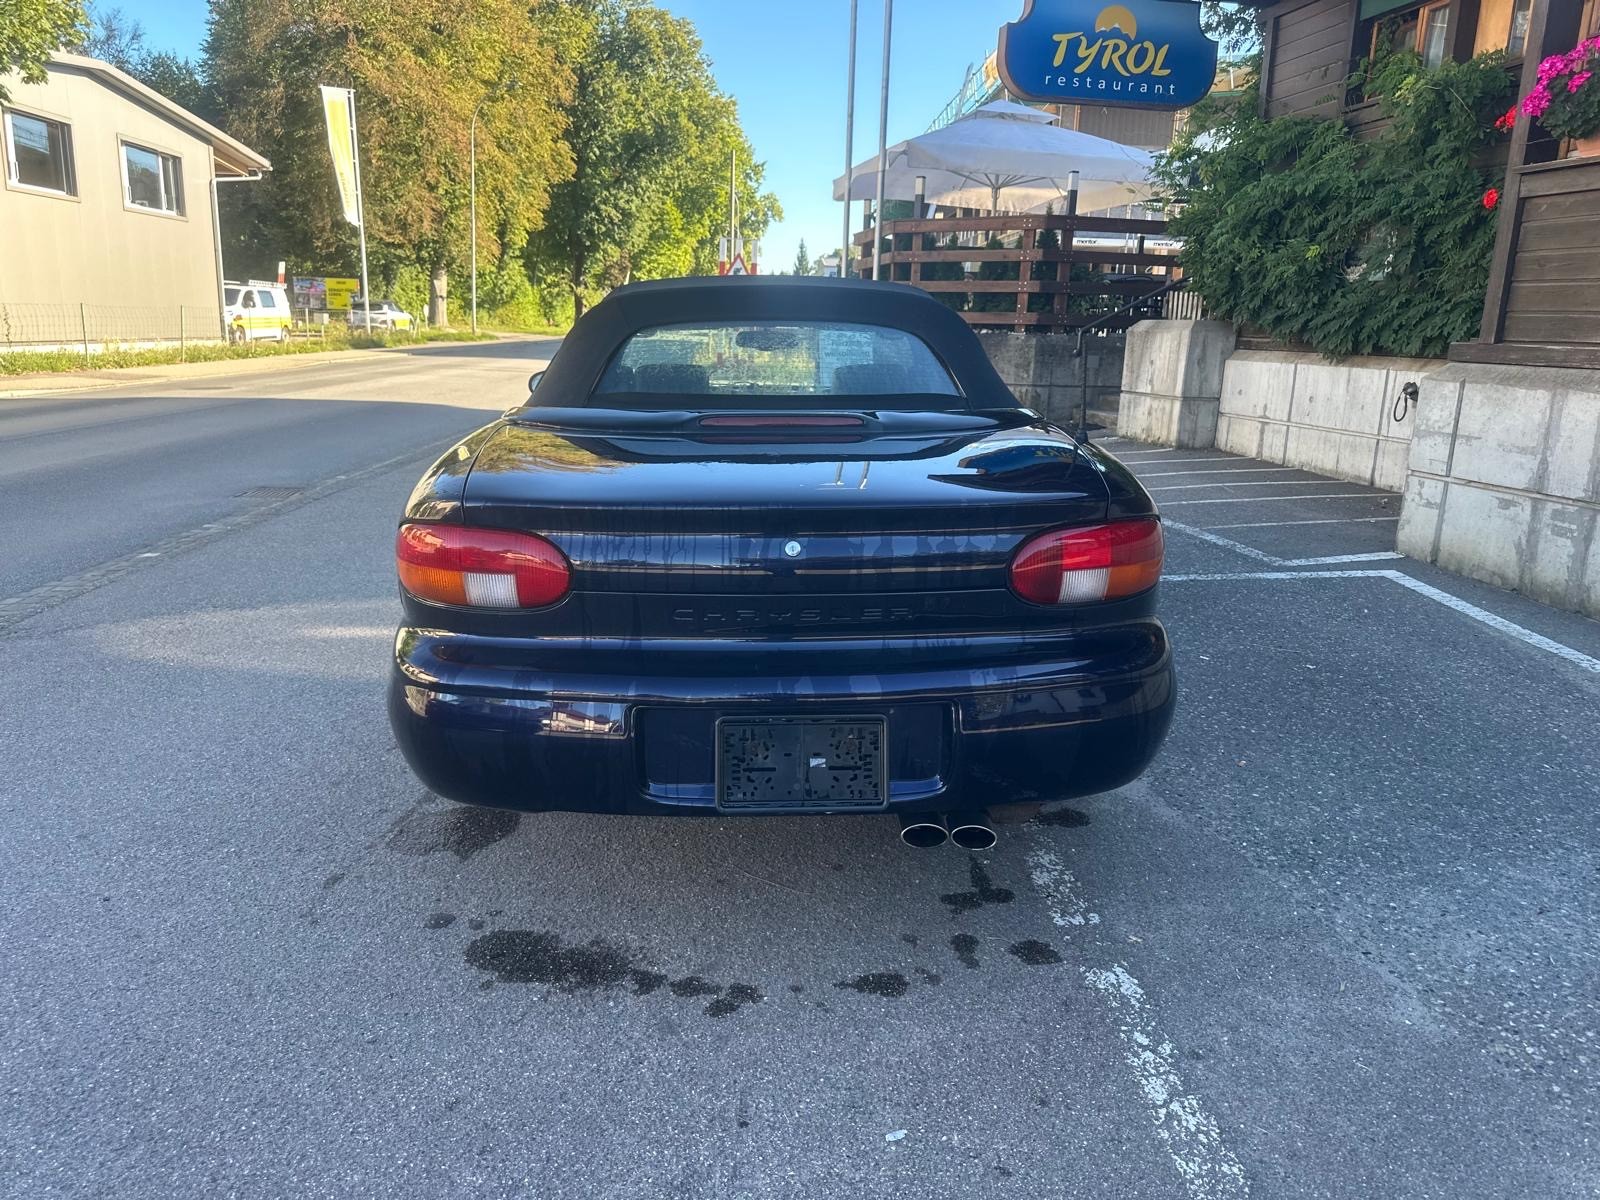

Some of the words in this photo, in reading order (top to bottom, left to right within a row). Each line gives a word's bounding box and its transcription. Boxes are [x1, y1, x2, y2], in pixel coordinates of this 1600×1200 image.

[1052, 31, 1171, 76] TYROL
[1045, 74, 1176, 95] restaurant
[672, 608, 914, 622] CHRYSLER
